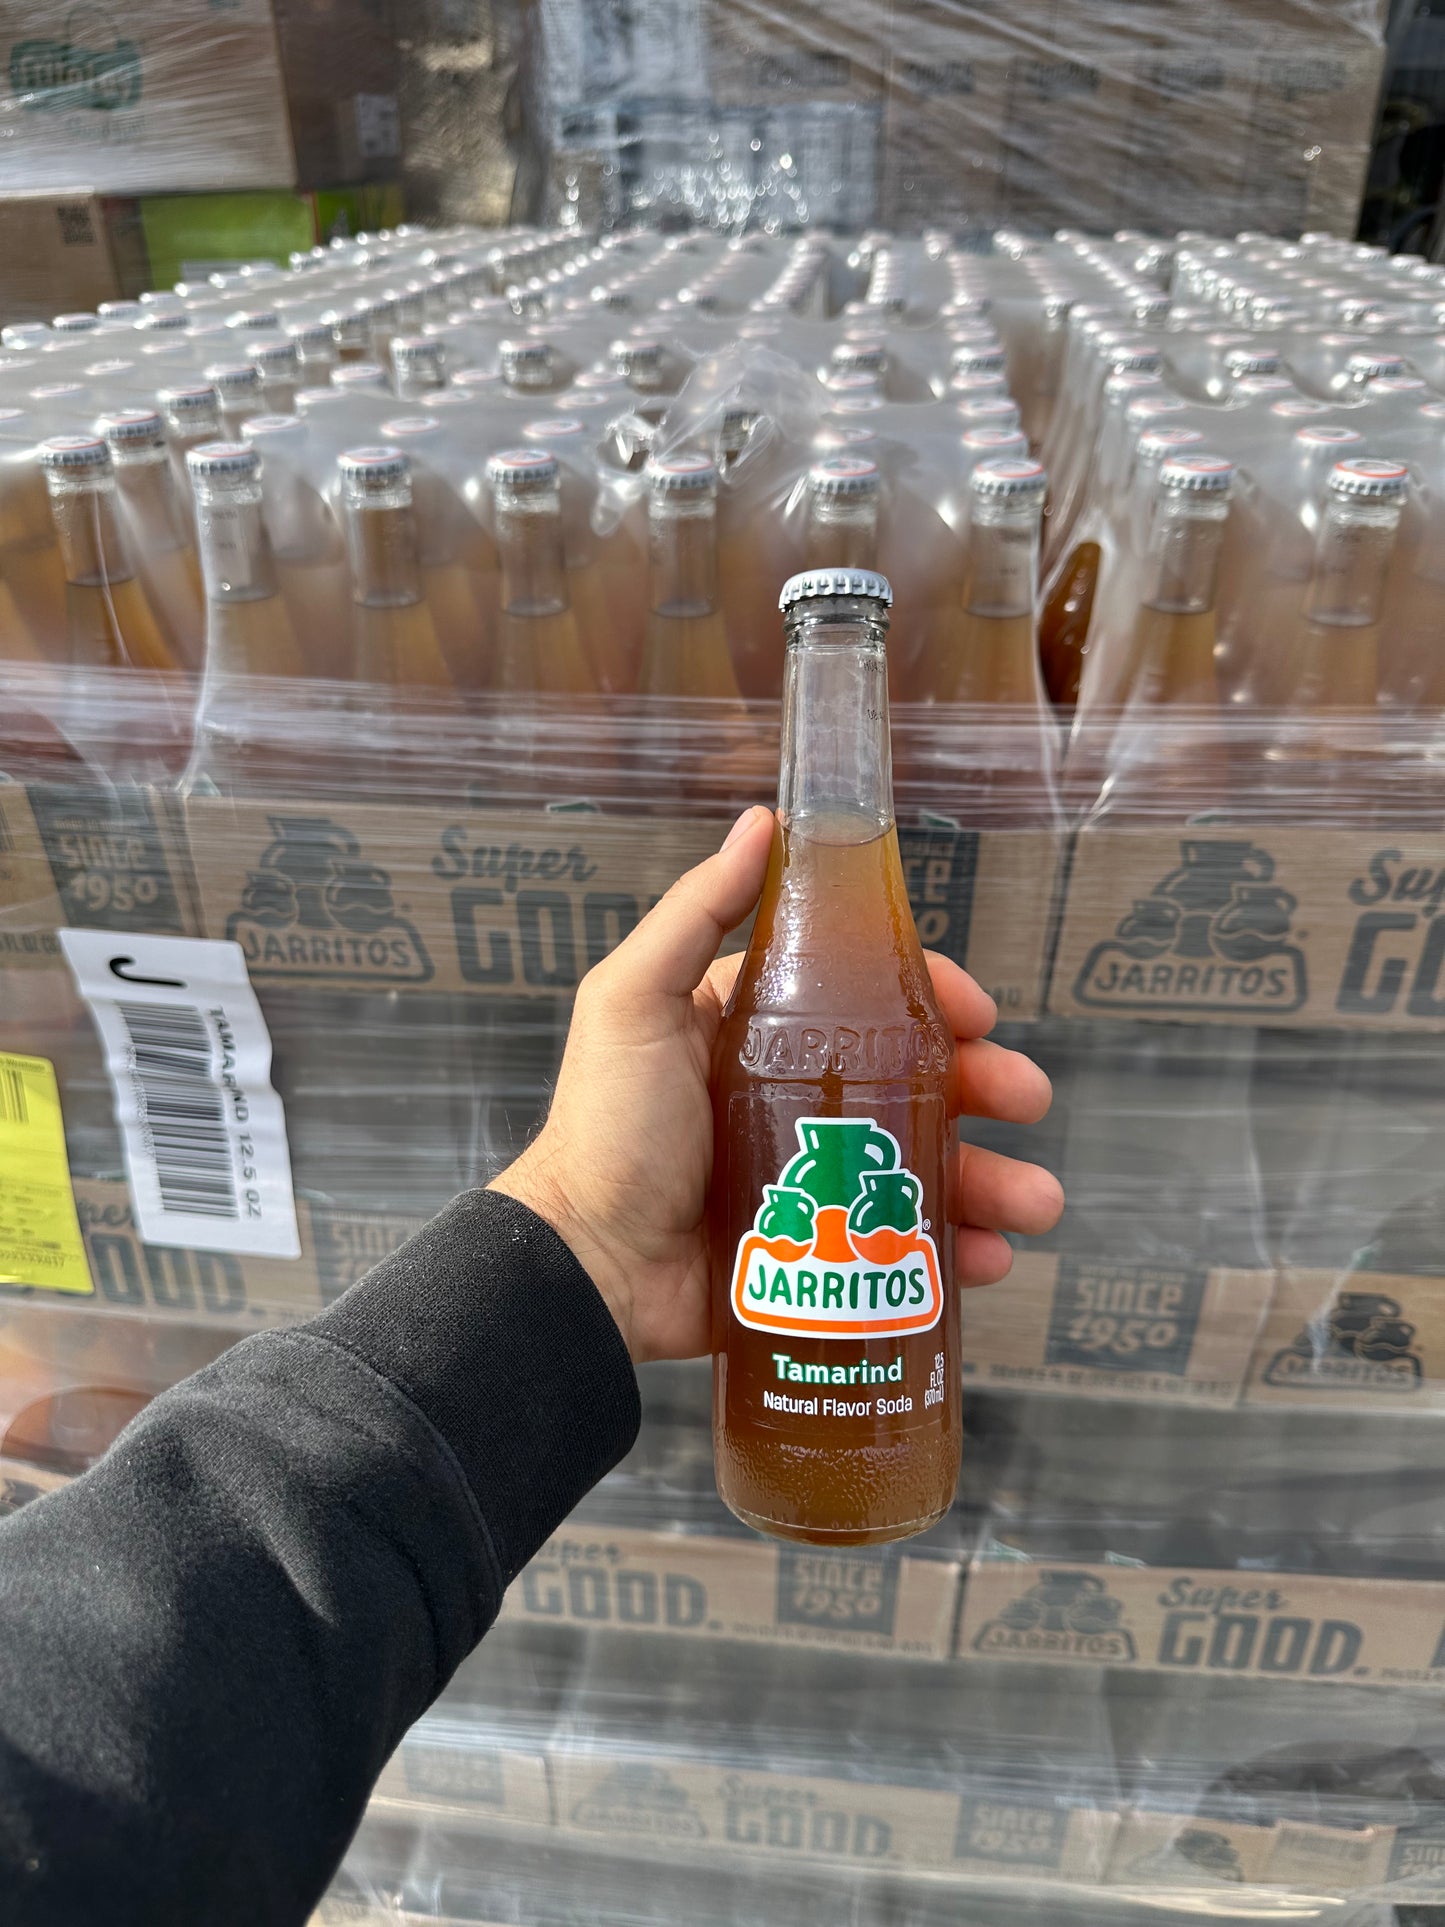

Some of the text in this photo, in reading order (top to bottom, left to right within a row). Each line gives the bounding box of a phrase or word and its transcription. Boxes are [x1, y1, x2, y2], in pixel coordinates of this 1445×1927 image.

[431, 824, 598, 893] Super
[70, 872, 158, 912] 1950
[247, 932, 411, 968] JARRITOS
[1094, 963, 1288, 997] JARRITOS
[739, 1025, 949, 1074] JARRITOS
[210, 1004, 249, 1125] TAMARND
[246, 1188, 263, 1218] OZ
[748, 1264, 926, 1310] JARRITOS
[1074, 1277, 1184, 1318] SINCE
[1068, 1312, 1179, 1356] 1950
[772, 1353, 904, 1385] Tamarind
[763, 1391, 913, 1417] Natural Flavor Soda
[538, 1538, 621, 1567] uper
[795, 1557, 882, 1592] SINCE
[793, 1585, 880, 1620] 1950
[1156, 1576, 1286, 1616] Super
[988, 1630, 1124, 1656] JARRITOS
